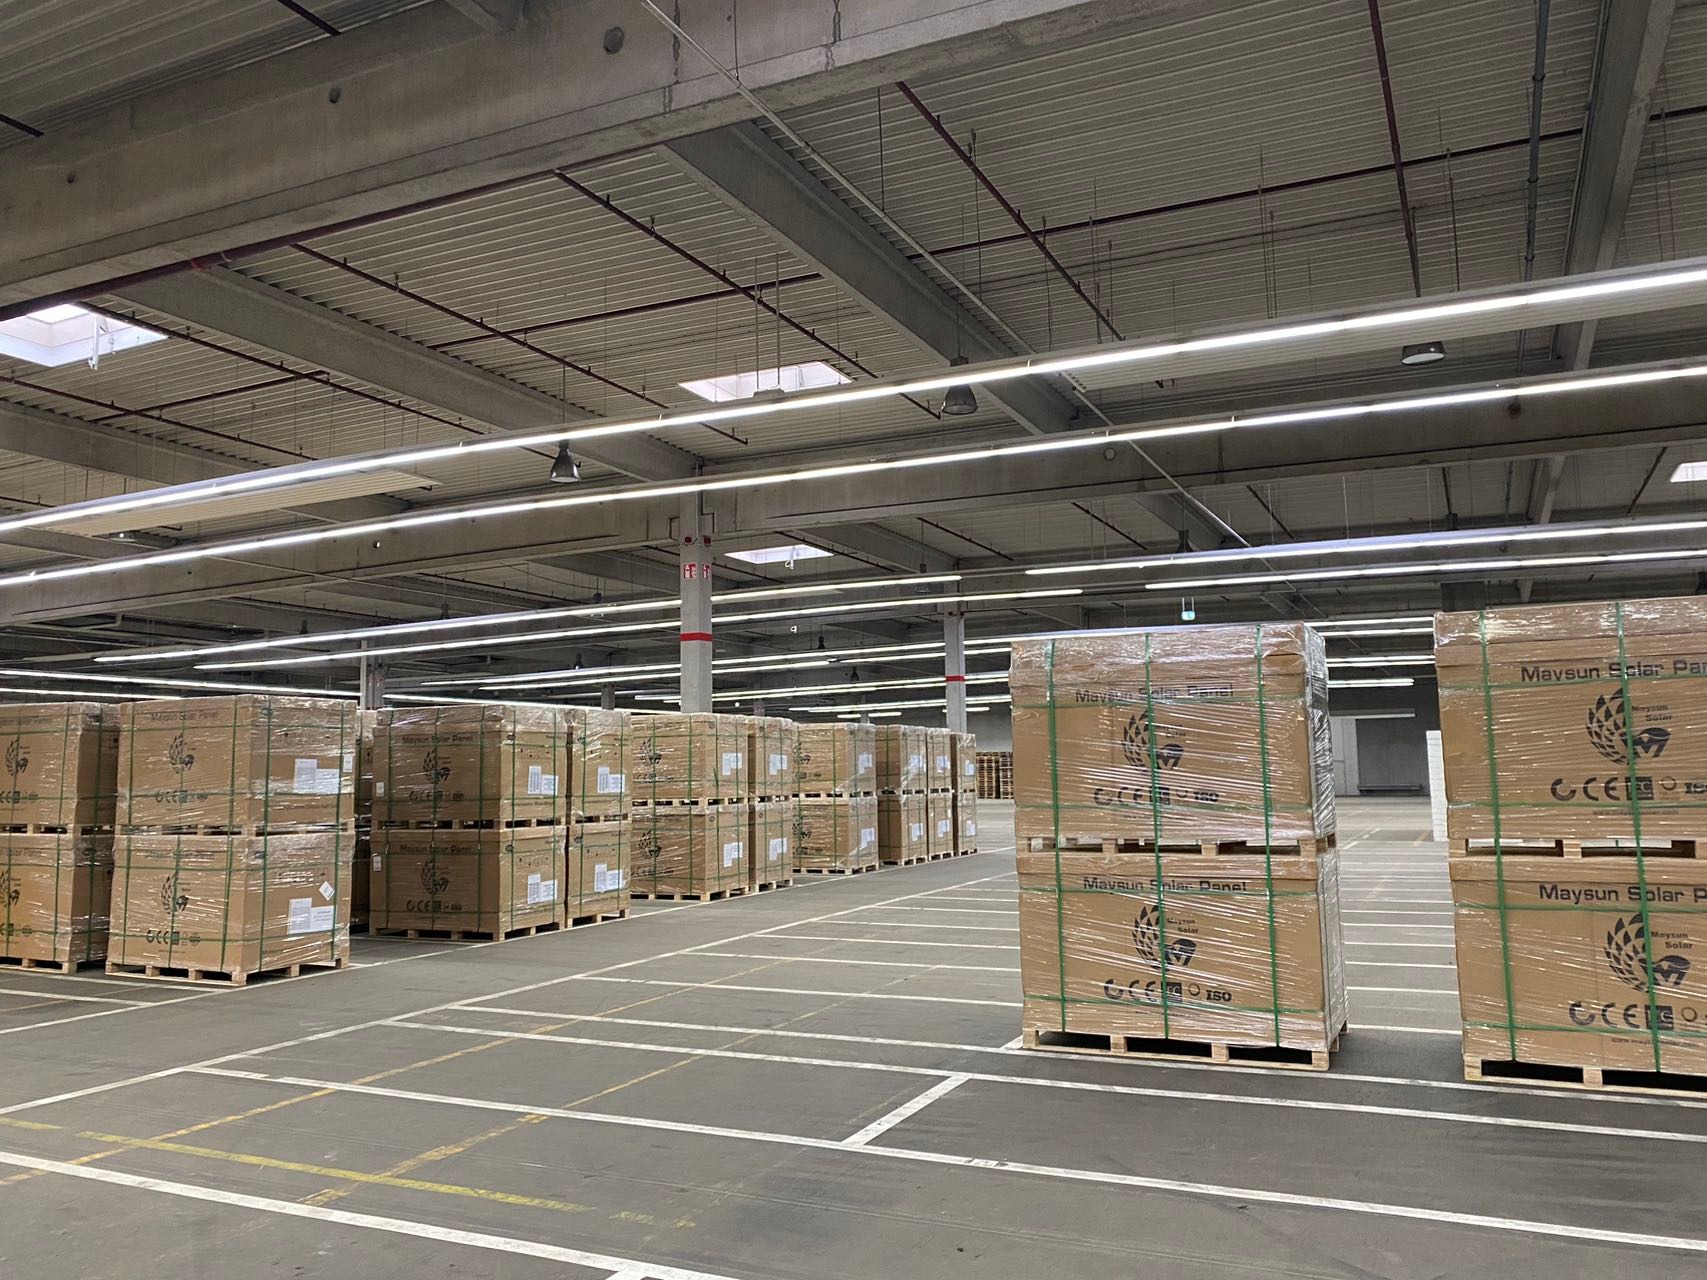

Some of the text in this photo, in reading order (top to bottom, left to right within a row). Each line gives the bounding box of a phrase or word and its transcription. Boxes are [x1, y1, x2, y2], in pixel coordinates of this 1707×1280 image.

[1521, 666, 1600, 683] Maysun
[1608, 662, 1664, 679] Solar
[1684, 782, 1707, 795] IS
[1199, 879, 1247, 894] Panel
[1539, 884, 1619, 905] Maysun
[1627, 885, 1684, 903] Solar
[1651, 930, 1689, 940] Maysun
[1665, 941, 1694, 950] Solar
[1205, 988, 1232, 1002] ISO
